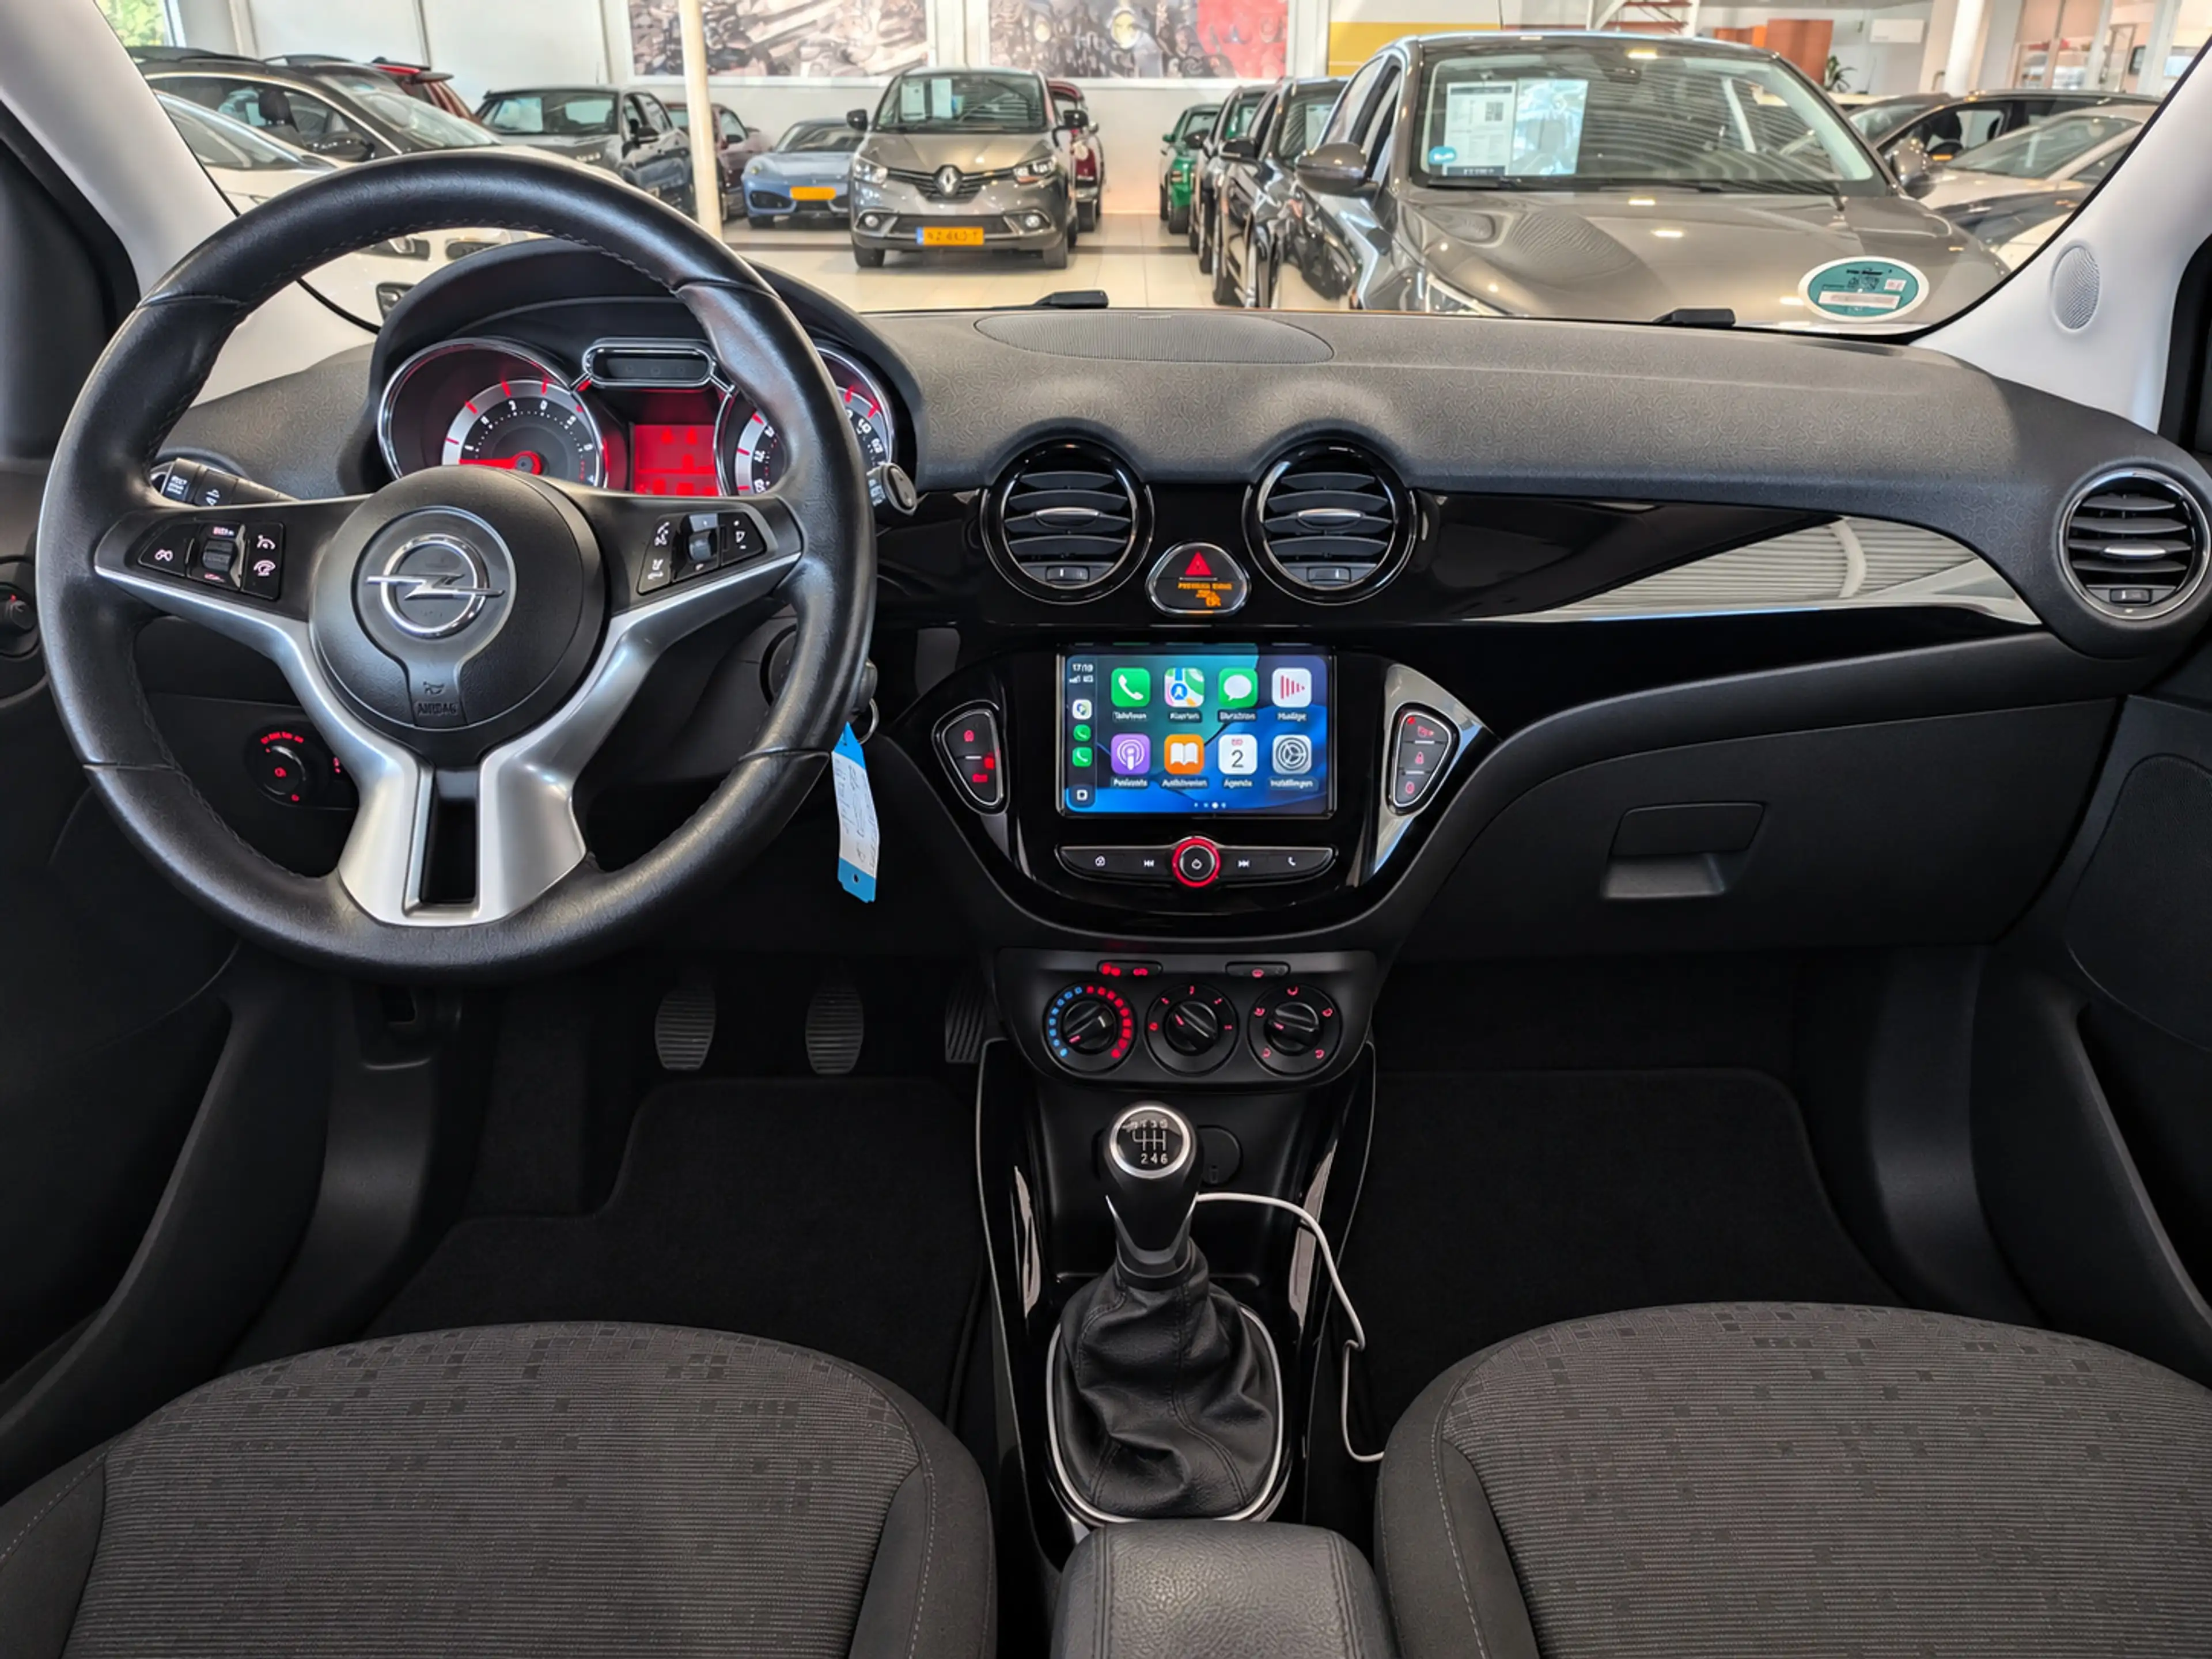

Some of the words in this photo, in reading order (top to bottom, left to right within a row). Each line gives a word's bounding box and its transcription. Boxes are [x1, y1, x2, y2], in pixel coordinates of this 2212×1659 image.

[1231, 749, 1244, 768] 2
[1141, 1153, 1149, 1164] 2
[1150, 1153, 1158, 1164] 4
[1160, 1153, 1168, 1164] 6
